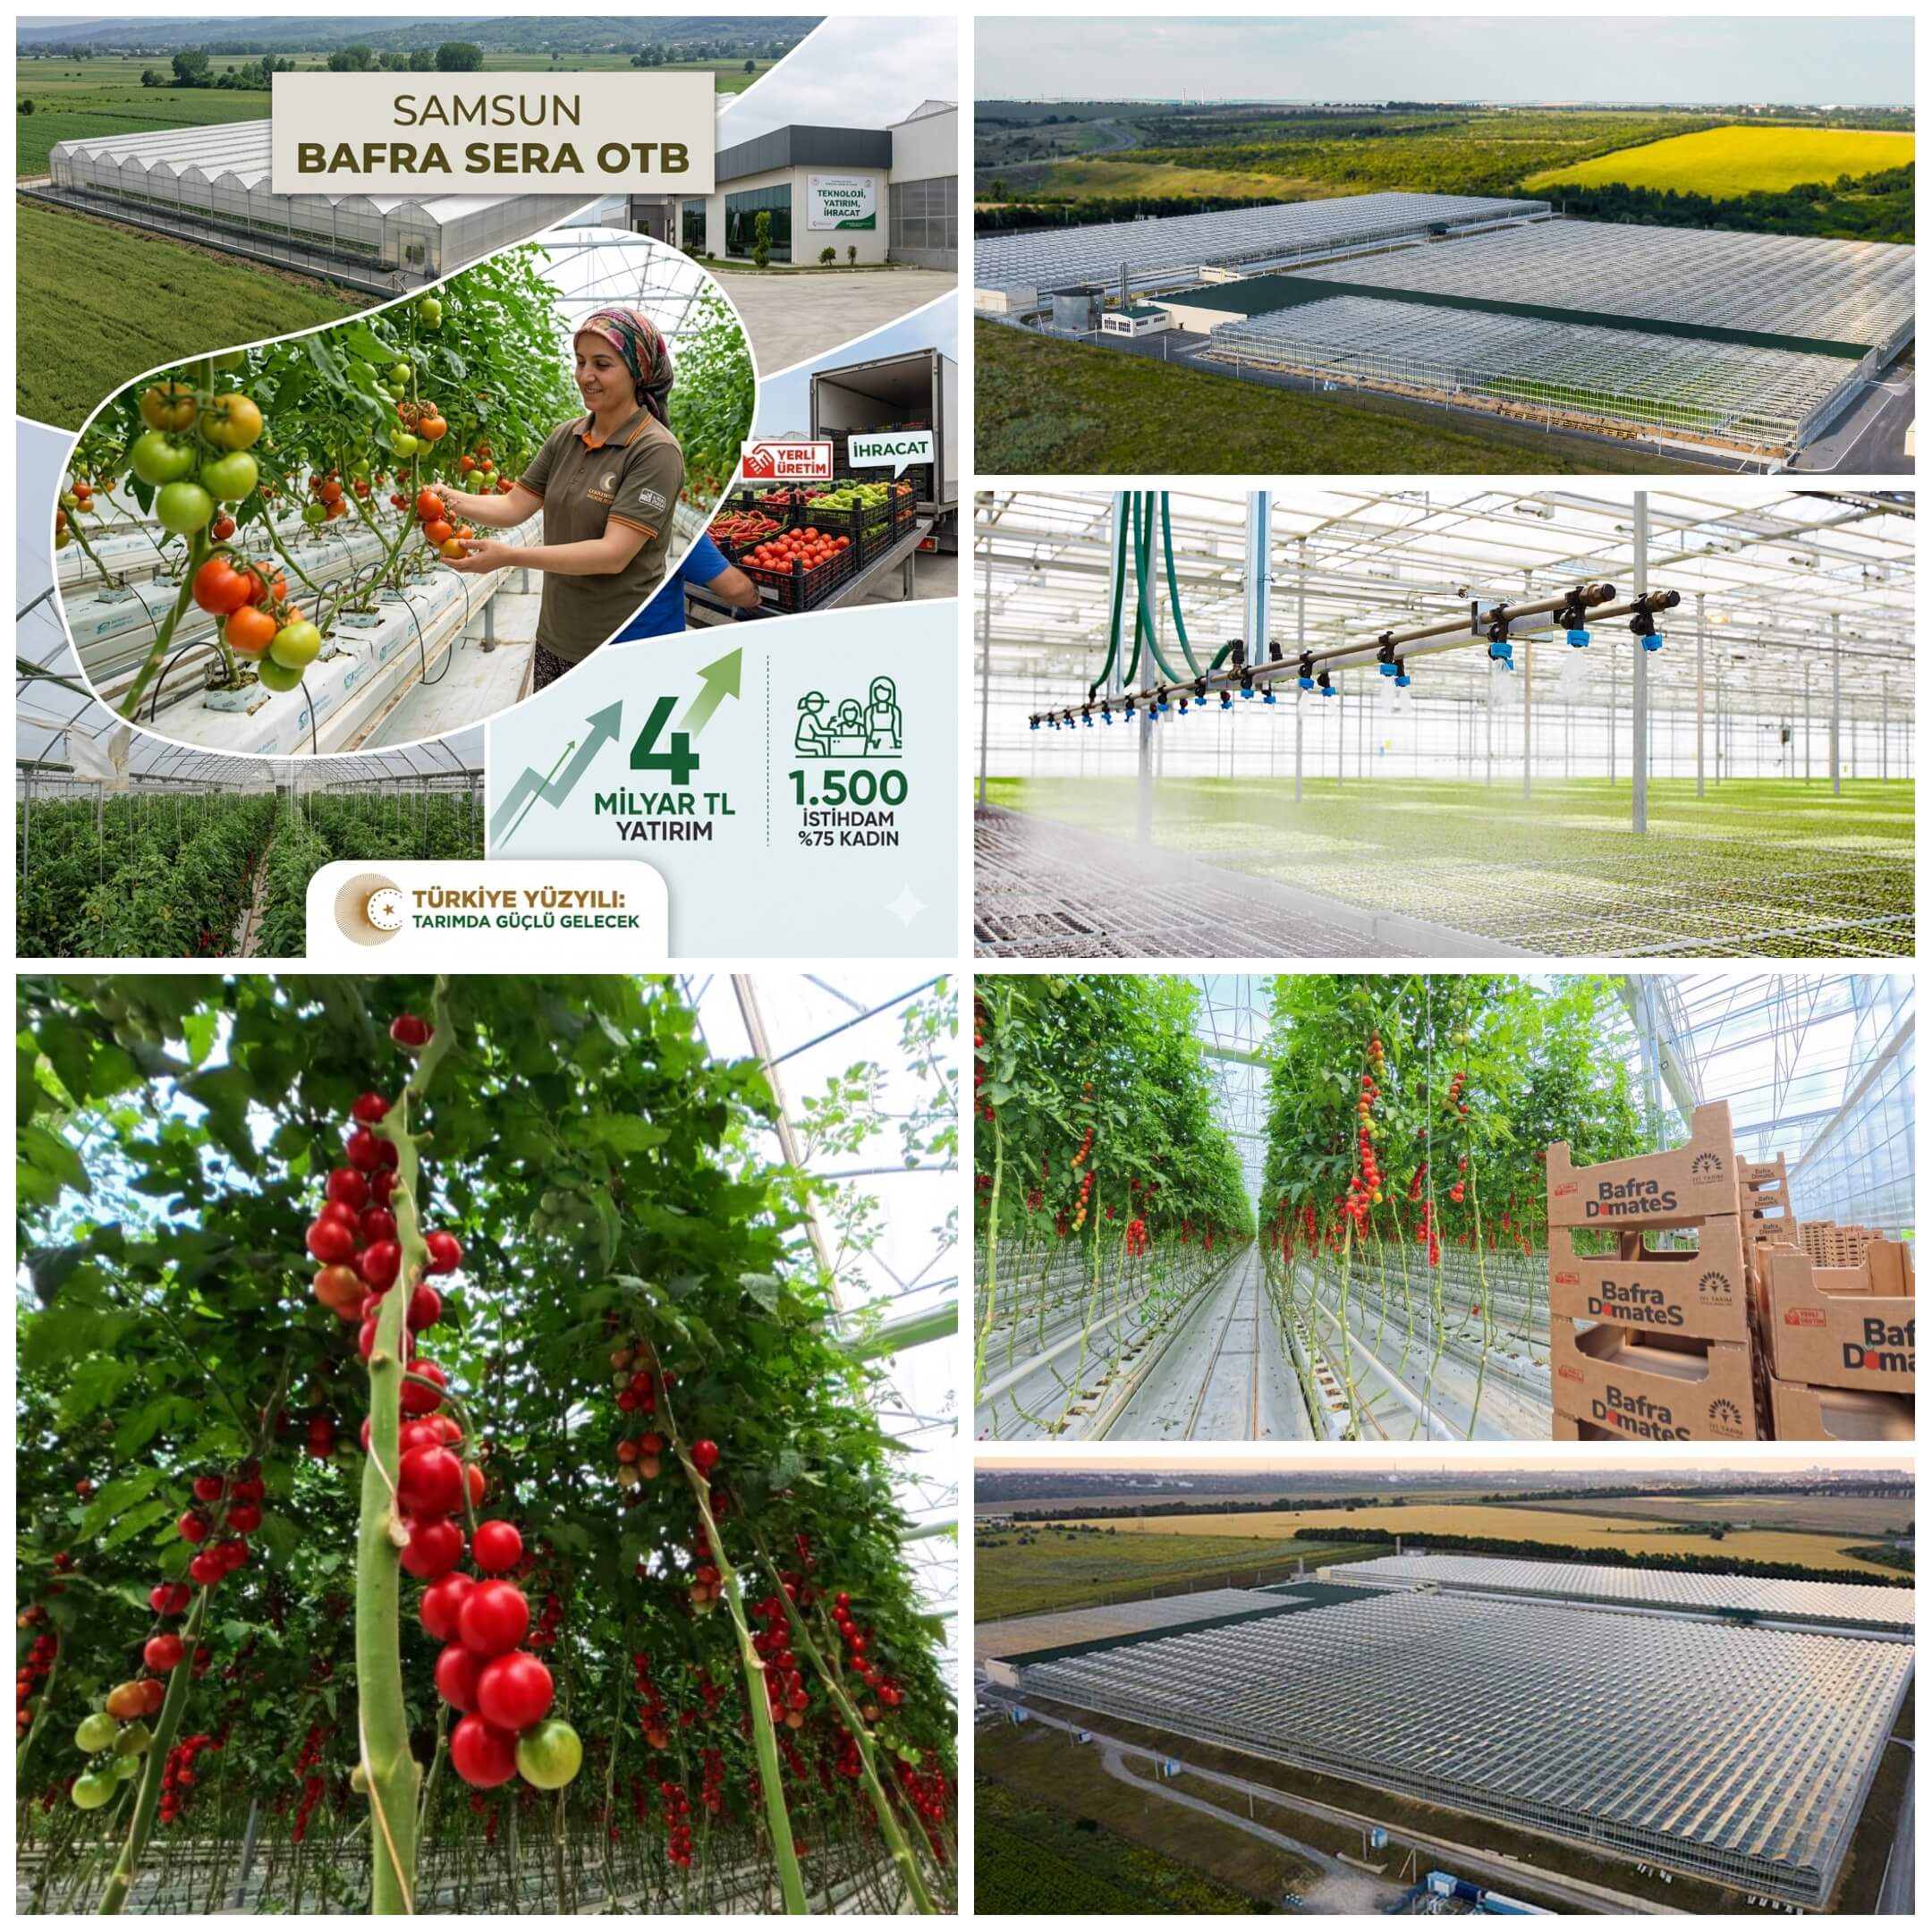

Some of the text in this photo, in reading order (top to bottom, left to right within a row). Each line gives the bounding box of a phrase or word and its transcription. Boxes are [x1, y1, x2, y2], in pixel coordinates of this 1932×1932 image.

[817, 188, 867, 199] TEKNOLOJİ,
[823, 199, 861, 208] YATIRIM,
[823, 207, 861, 216] İHRACAT
[1598, 1178, 1659, 1200] Bafra
[1601, 1280, 1665, 1305] Bafra
[1606, 1385, 1673, 1425] Bafra
